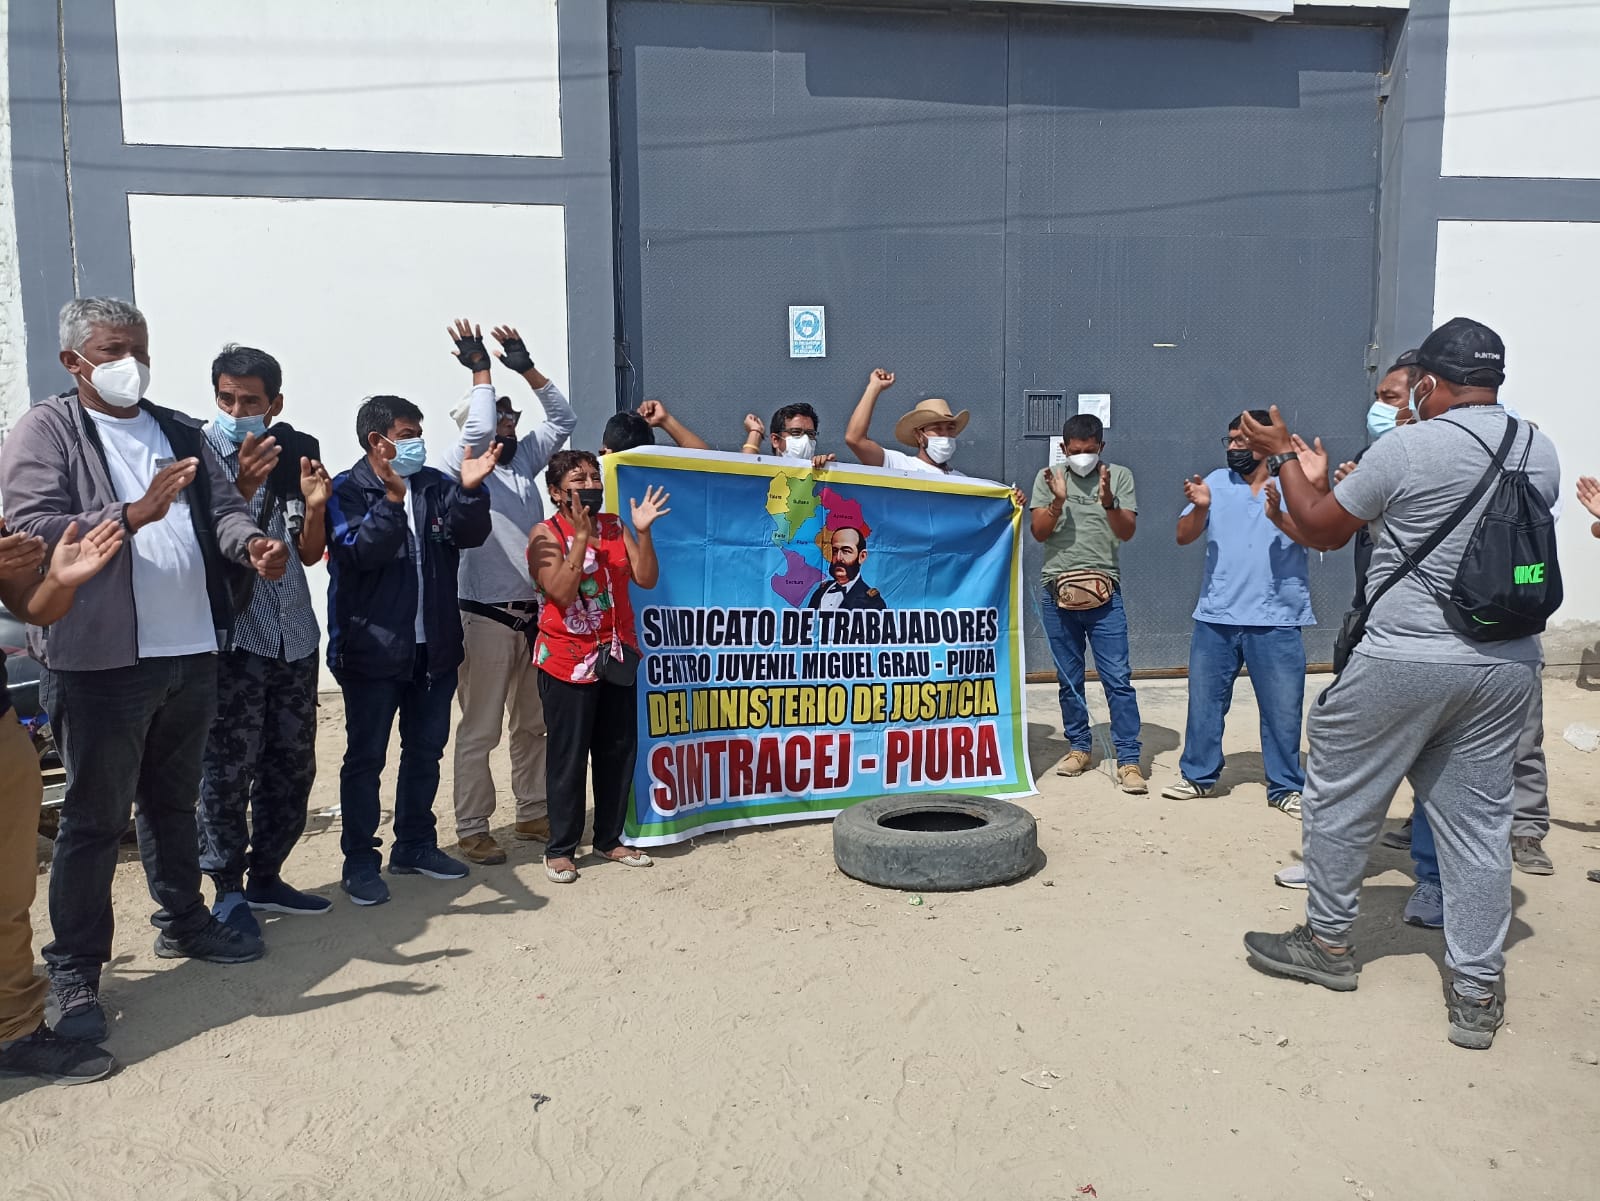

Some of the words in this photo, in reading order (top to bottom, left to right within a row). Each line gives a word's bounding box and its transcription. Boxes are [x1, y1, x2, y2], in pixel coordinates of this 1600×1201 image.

[643, 608, 776, 648] SINDICATO
[782, 609, 813, 647] DE
[818, 608, 998, 645] TRABAJADORES
[647, 653, 711, 685] CENTRO
[715, 653, 798, 682] JUVENIL
[801, 652, 874, 680] MIGUEL
[878, 651, 931, 678] GRAU
[947, 648, 996, 676] PIURA
[647, 690, 690, 737] DEL
[692, 685, 847, 731] MINISTERIO
[852, 683, 887, 724] DE
[889, 678, 999, 723] JUSTICIA
[651, 733, 851, 811] SINTRACEJ
[861, 758, 876, 769] -
[886, 723, 1003, 785] PIURA
